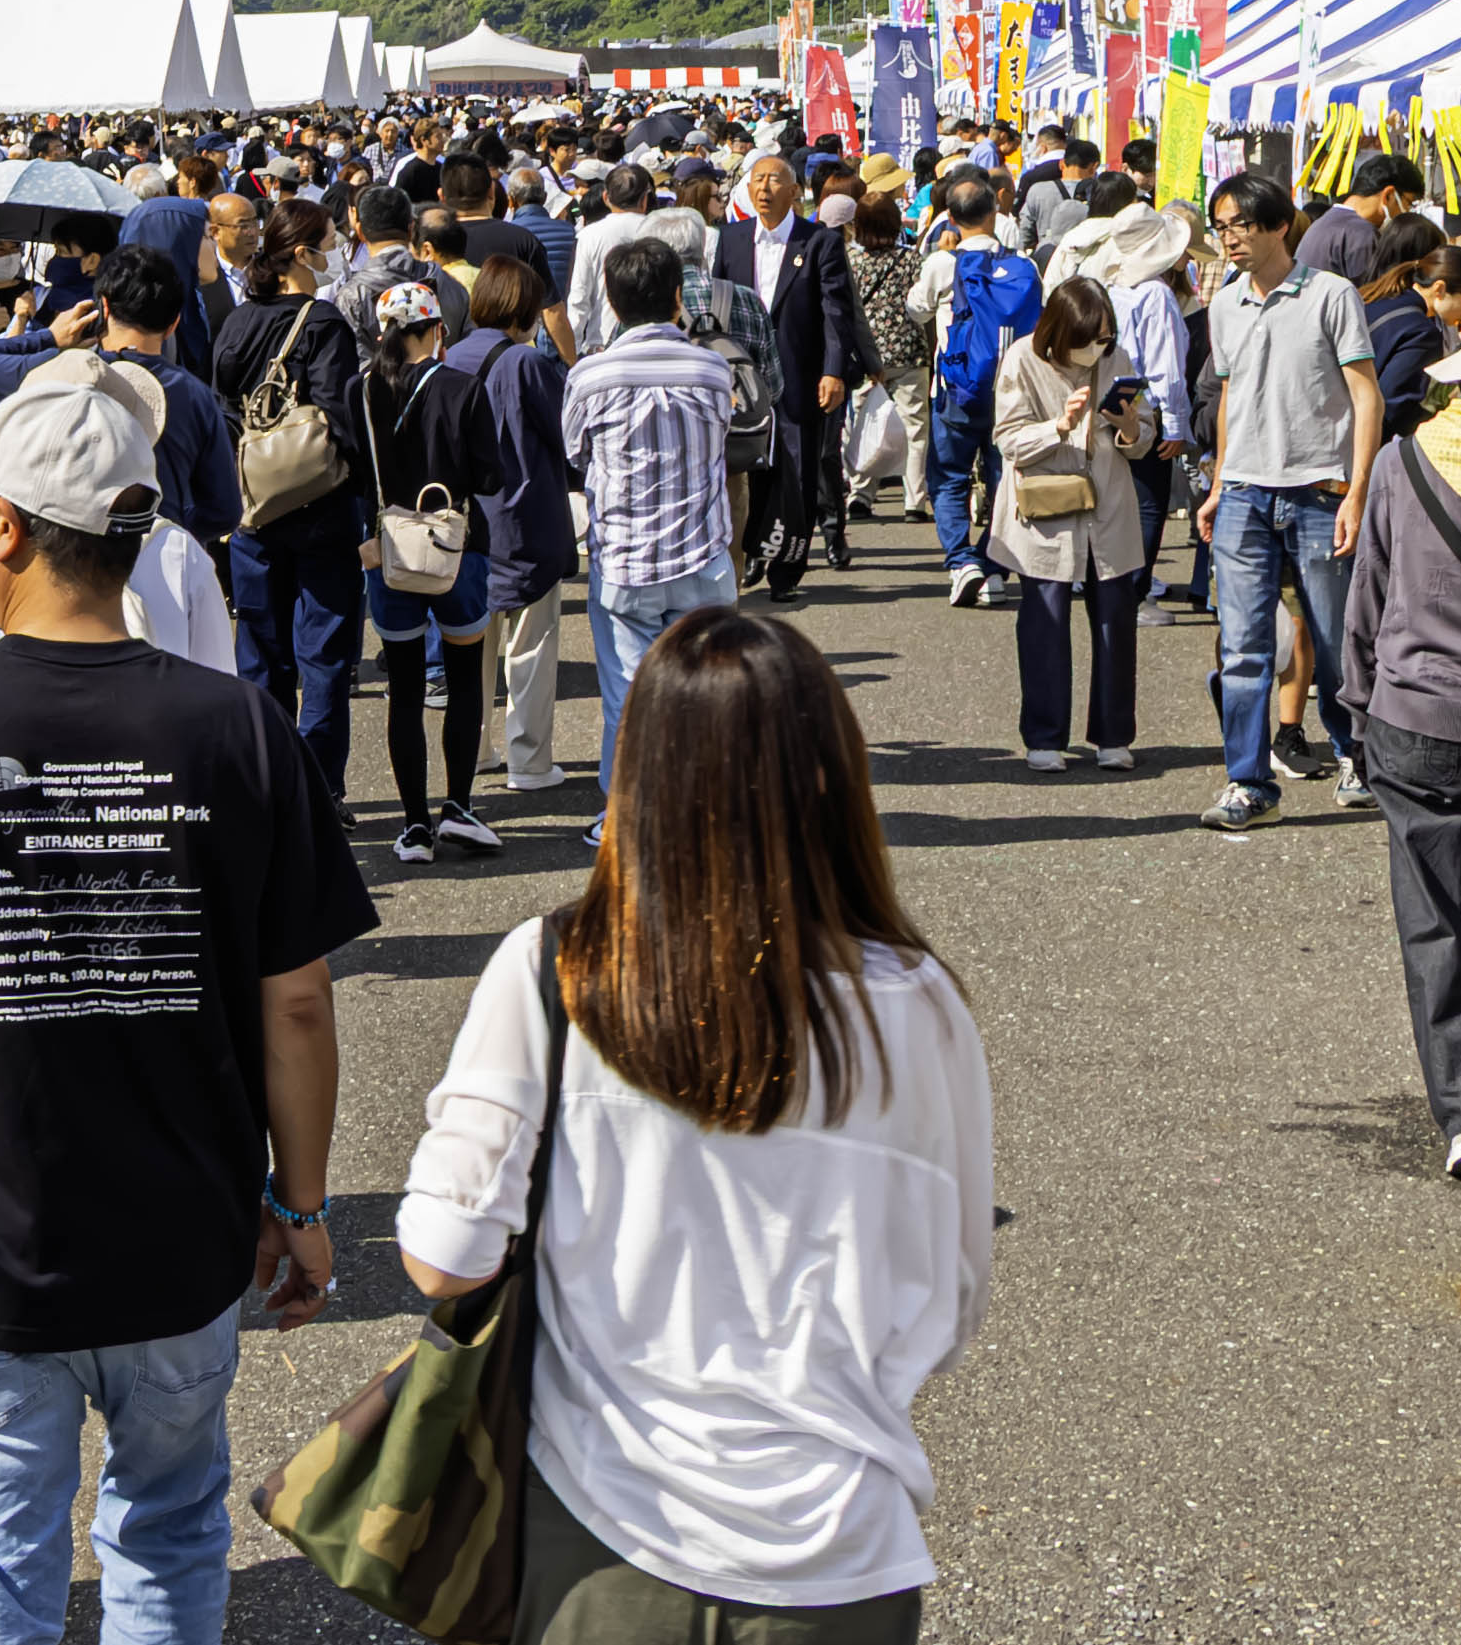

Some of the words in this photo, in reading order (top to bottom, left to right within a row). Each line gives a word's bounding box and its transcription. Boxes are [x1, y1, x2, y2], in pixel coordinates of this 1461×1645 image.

[43, 762, 100, 773] Government
[103, 762, 114, 772] of
[115, 761, 143, 774] Nepal
[15, 774, 69, 787] Department
[71, 774, 82, 784] of
[83, 774, 122, 785] National
[124, 773, 152, 784] Parks
[153, 773, 173, 783] and
[42, 787, 79, 797] Wildlife
[80, 786, 144, 797] Conservation
[95, 805, 169, 823] National
[172, 804, 211, 822] Park
[25, 835, 106, 849] ENTRANCE
[108, 834, 164, 848] PERMIT
[38, 874, 66, 891] The
[74, 870, 130, 890] North
[139, 870, 178, 887] Face
[19, 952, 31, 963] of
[32, 951, 65, 962] Birth:
[24, 973, 48, 984] Fee:
[49, 972, 70, 983] Rs.
[71, 969, 104, 981] 100.00
[105, 970, 127, 982] Per
[129, 971, 150, 984] day
[151, 969, 197, 981] Person.
